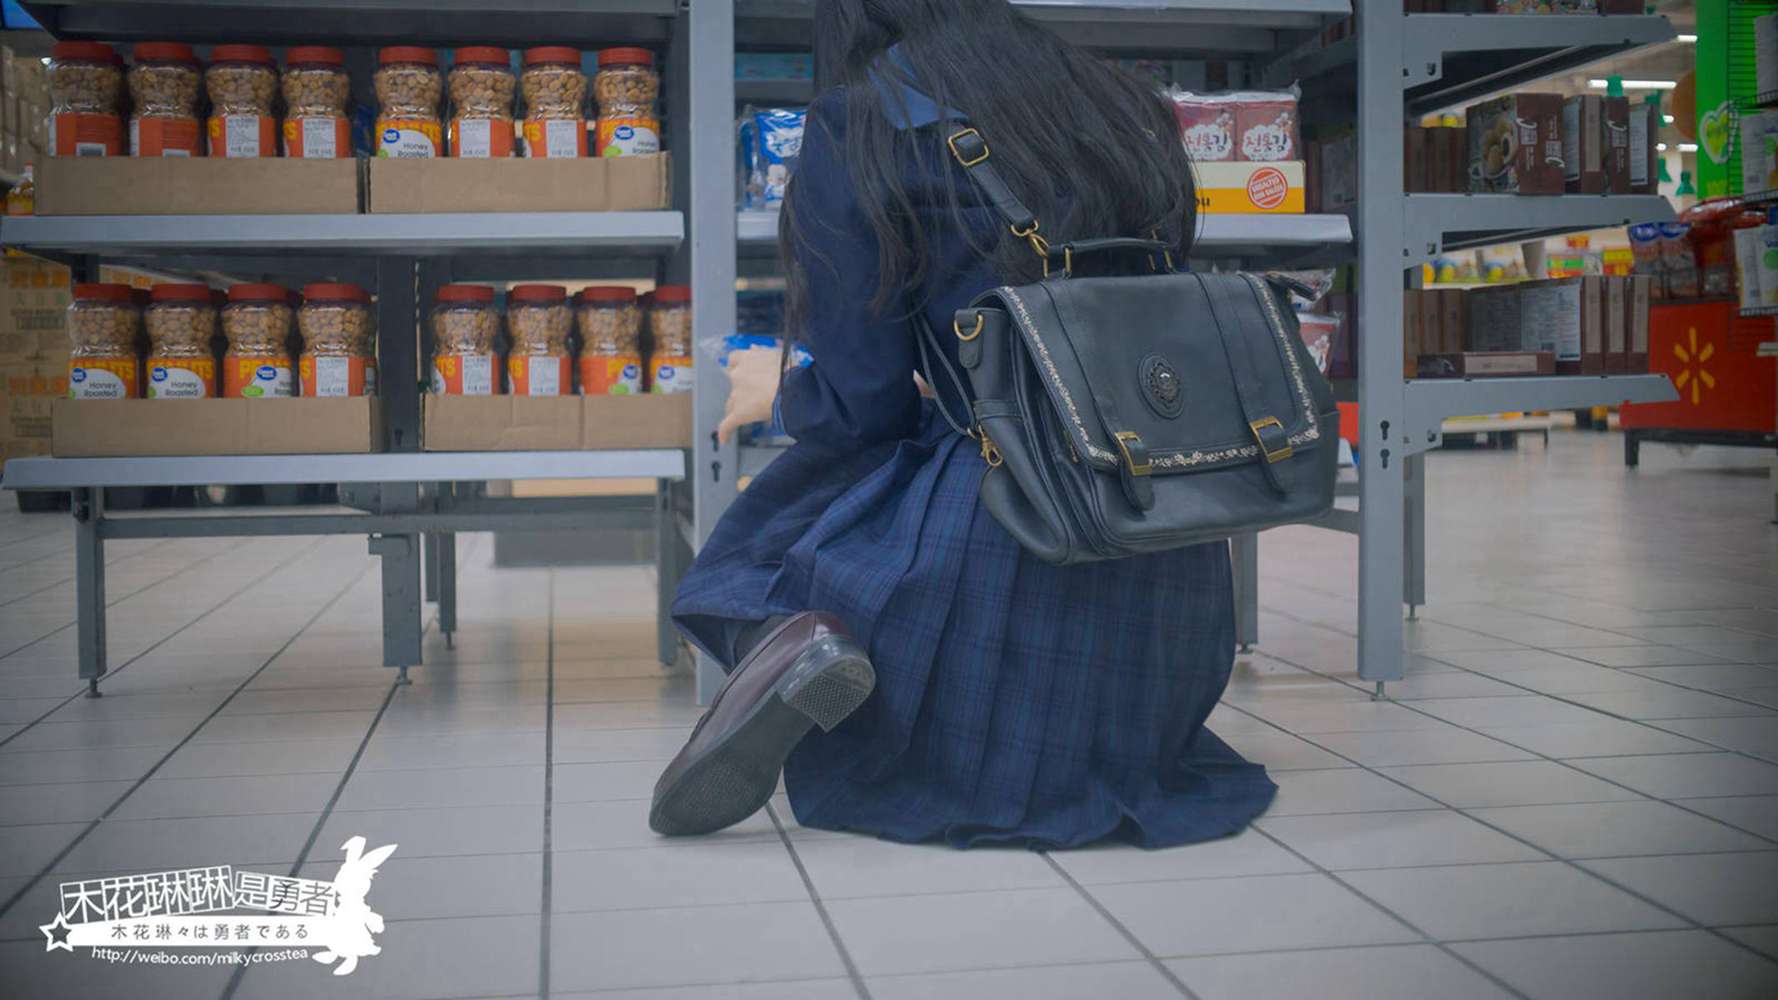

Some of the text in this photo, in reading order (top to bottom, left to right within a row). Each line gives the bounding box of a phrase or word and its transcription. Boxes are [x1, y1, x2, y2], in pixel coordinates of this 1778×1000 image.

[88, 382, 117, 390] Honey
[170, 382, 198, 390] Honey
[83, 389, 118, 397] Roasted
[164, 389, 199, 397] Roasted
